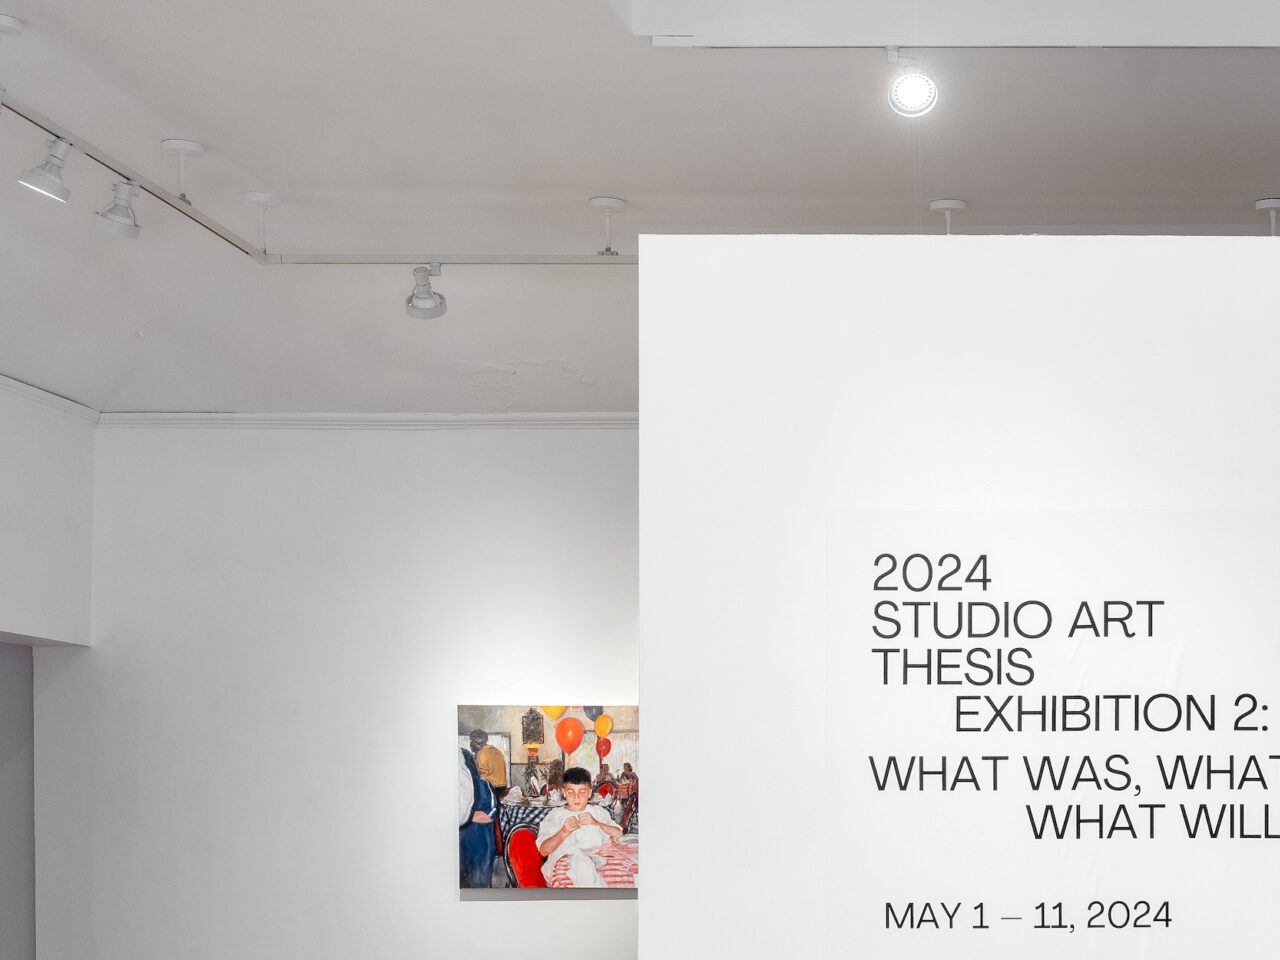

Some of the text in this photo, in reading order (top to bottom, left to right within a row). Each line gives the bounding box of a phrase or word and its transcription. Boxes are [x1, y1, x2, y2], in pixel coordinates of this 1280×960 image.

[873, 552, 992, 593] 2024
[871, 599, 1165, 640] STUDIO ART
[871, 646, 1035, 687] THESIS
[955, 692, 1269, 733] EXHIBITION 2:
[868, 755, 1010, 792] WHAT
[1022, 753, 1142, 797] WAS,
[1025, 803, 1167, 840] WHAT
[885, 901, 962, 930] MAY
[972, 902, 990, 930] 1
[1033, 901, 1076, 934] 11,
[1086, 900, 1173, 930] 2024
